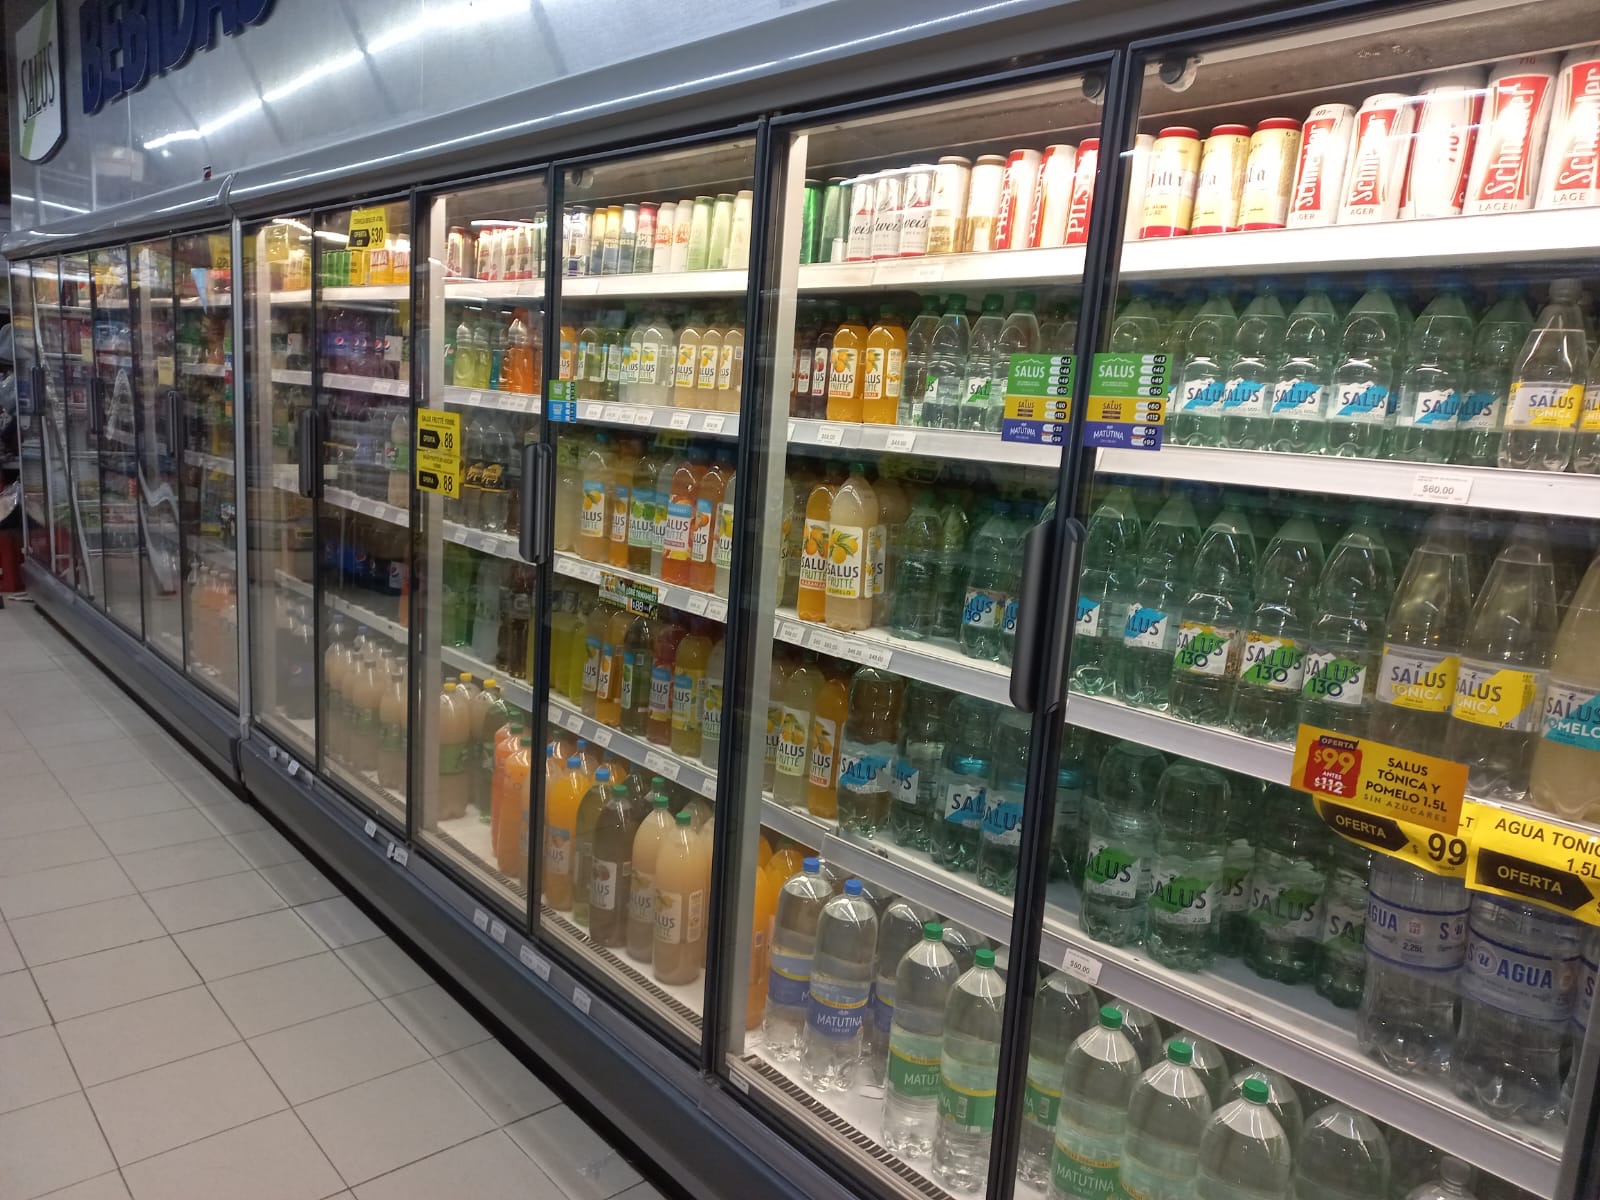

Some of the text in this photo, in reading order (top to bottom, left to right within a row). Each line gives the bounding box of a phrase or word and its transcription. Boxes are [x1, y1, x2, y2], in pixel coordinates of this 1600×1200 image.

[22, 42, 55, 124] SALUS
[1015, 365, 1046, 378] SALUS
[1099, 365, 1136, 378] SALUS
[1274, 388, 1316, 404] SALUS
[1342, 391, 1386, 409] SALUS
[1529, 394, 1574, 410] SALUS
[1421, 399, 1459, 416] SALU
[1460, 399, 1493, 416] ALUS
[444, 432, 454, 449] 88
[1093, 429, 1124, 440] MATUTINA
[443, 473, 453, 492] 88
[1422, 484, 1454, 496] $60.00
[666, 519, 689, 532] ALUS
[800, 556, 826, 571] SALU
[1177, 631, 1223, 657] SALUS
[1180, 651, 1209, 668] 130
[1246, 644, 1301, 670] SALUS
[1255, 665, 1288, 683] 130
[1305, 657, 1360, 685] SALUS
[1391, 666, 1447, 689] SALUS
[1311, 677, 1343, 697] 130
[778, 743, 805, 758] ALUS
[1320, 737, 1355, 750] OFERTA
[812, 754, 831, 768] LUS
[841, 757, 877, 781] SALU
[1313, 748, 1356, 775] $99
[1387, 757, 1429, 776] SALUS
[1322, 771, 1342, 781] ANTES
[1377, 768, 1441, 795] TÓNICA Y
[1314, 777, 1344, 794] $112
[952, 792, 985, 816] SAL
[1363, 793, 1381, 805] SIN
[1366, 781, 1448, 812] POMELO 1.5L
[1335, 814, 1387, 839] OFERTA
[1495, 818, 1545, 842] AGUA
[1428, 832, 1467, 866] 99
[1497, 865, 1563, 895] OFERTA
[1252, 888, 1315, 922] SALUS
[1497, 959, 1553, 989] AGUA
[817, 1013, 863, 1028] MATUTINA
[904, 1071, 941, 1086] MATUT
[1056, 1163, 1114, 1192] MATUTINA
